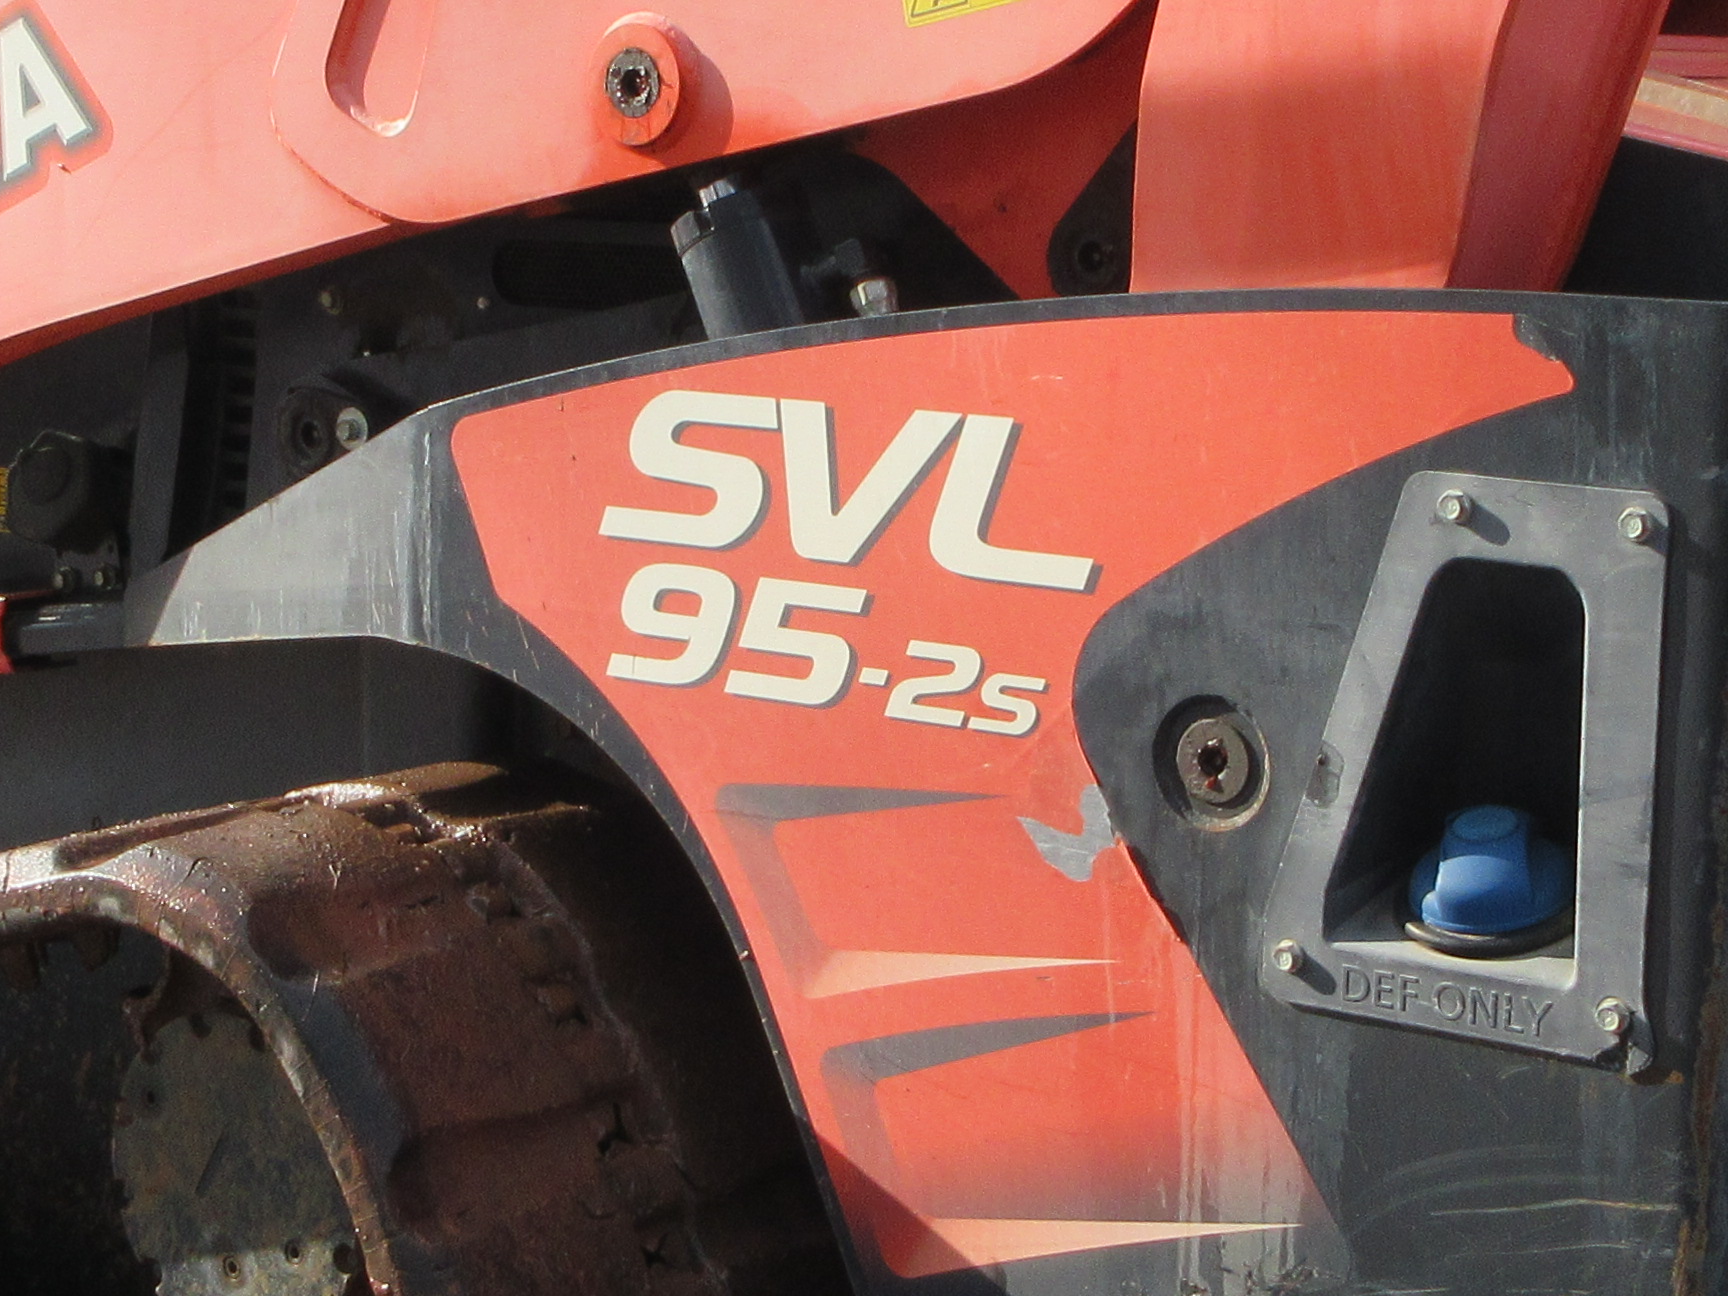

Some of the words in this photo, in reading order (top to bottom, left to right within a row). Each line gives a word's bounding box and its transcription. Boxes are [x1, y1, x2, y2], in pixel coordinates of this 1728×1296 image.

[598, 390, 1096, 593] SVL
[1340, 963, 1419, 1012] DEF
[1432, 980, 1554, 1037] ONLY
